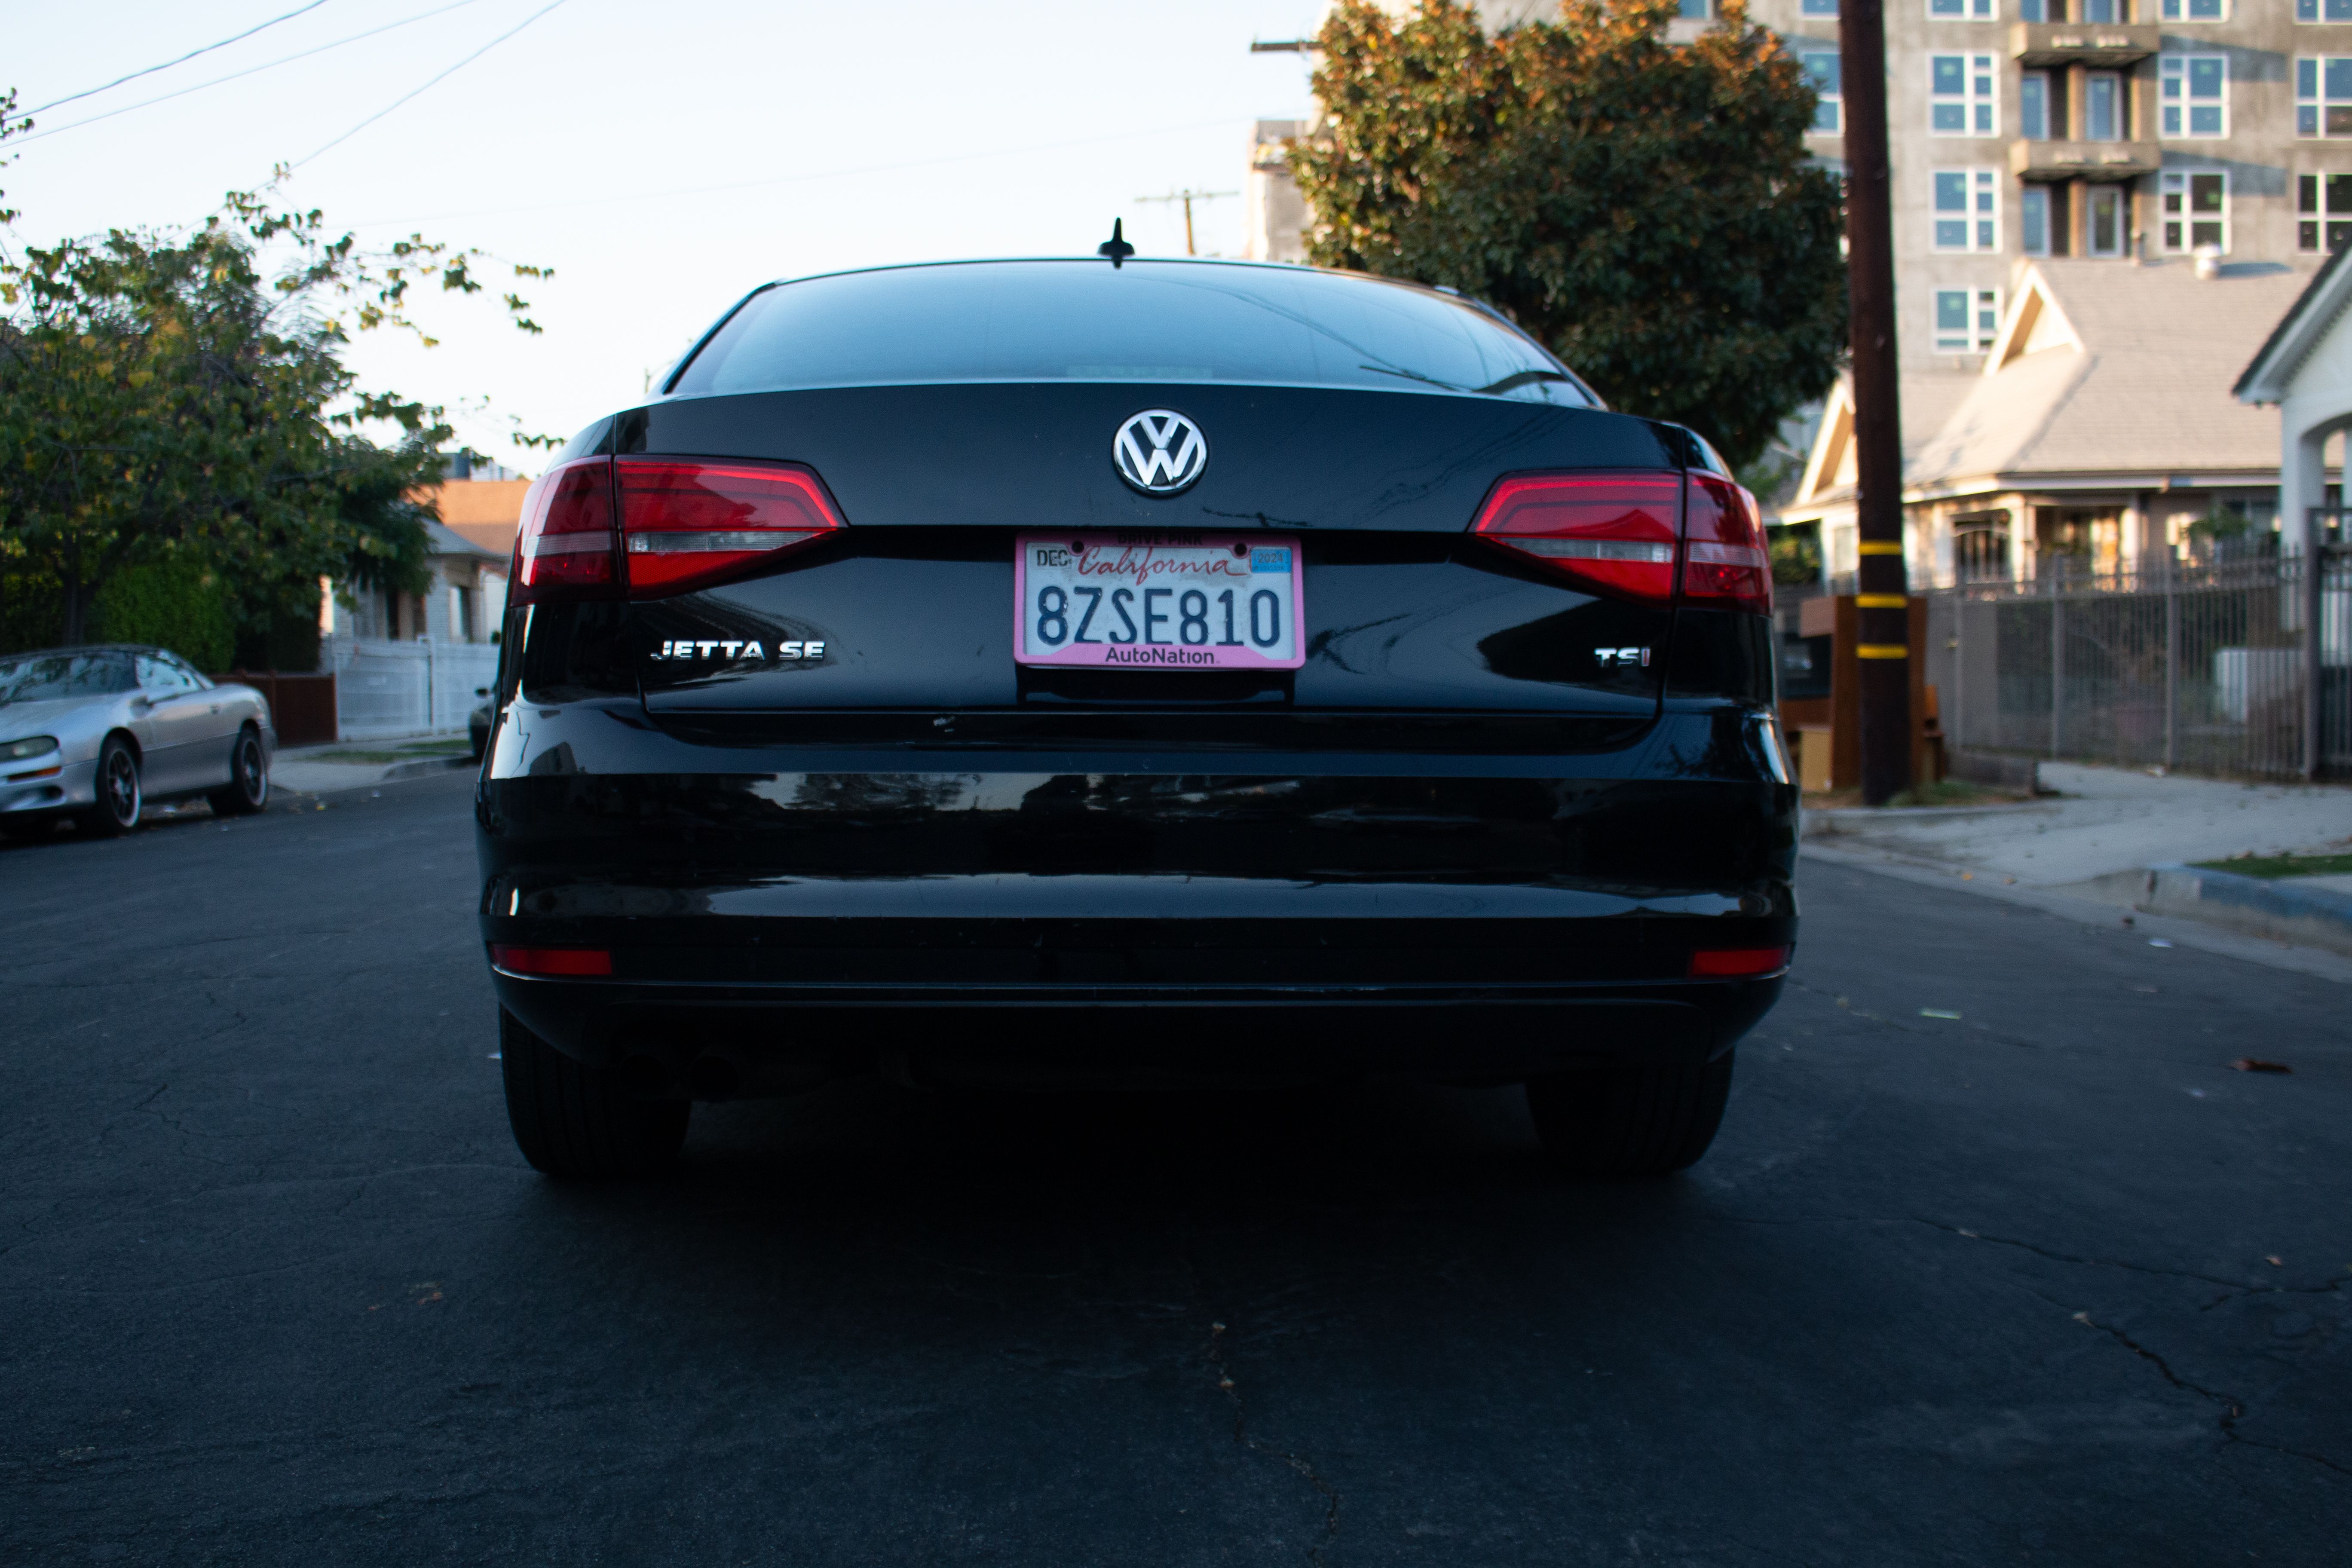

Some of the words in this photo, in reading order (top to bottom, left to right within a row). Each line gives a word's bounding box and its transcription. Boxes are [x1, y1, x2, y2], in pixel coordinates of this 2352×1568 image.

[1117, 533, 1161, 545] DRIVE
[1167, 533, 1203, 545] PINK
[1037, 550, 1068, 566] DEC
[1078, 546, 1247, 586] California
[1258, 553, 1283, 564] 2024
[1037, 586, 1280, 648] 8ZSE810
[650, 640, 765, 661] JETTA
[779, 640, 825, 661] SE
[1105, 647, 1214, 665] AutoNation
